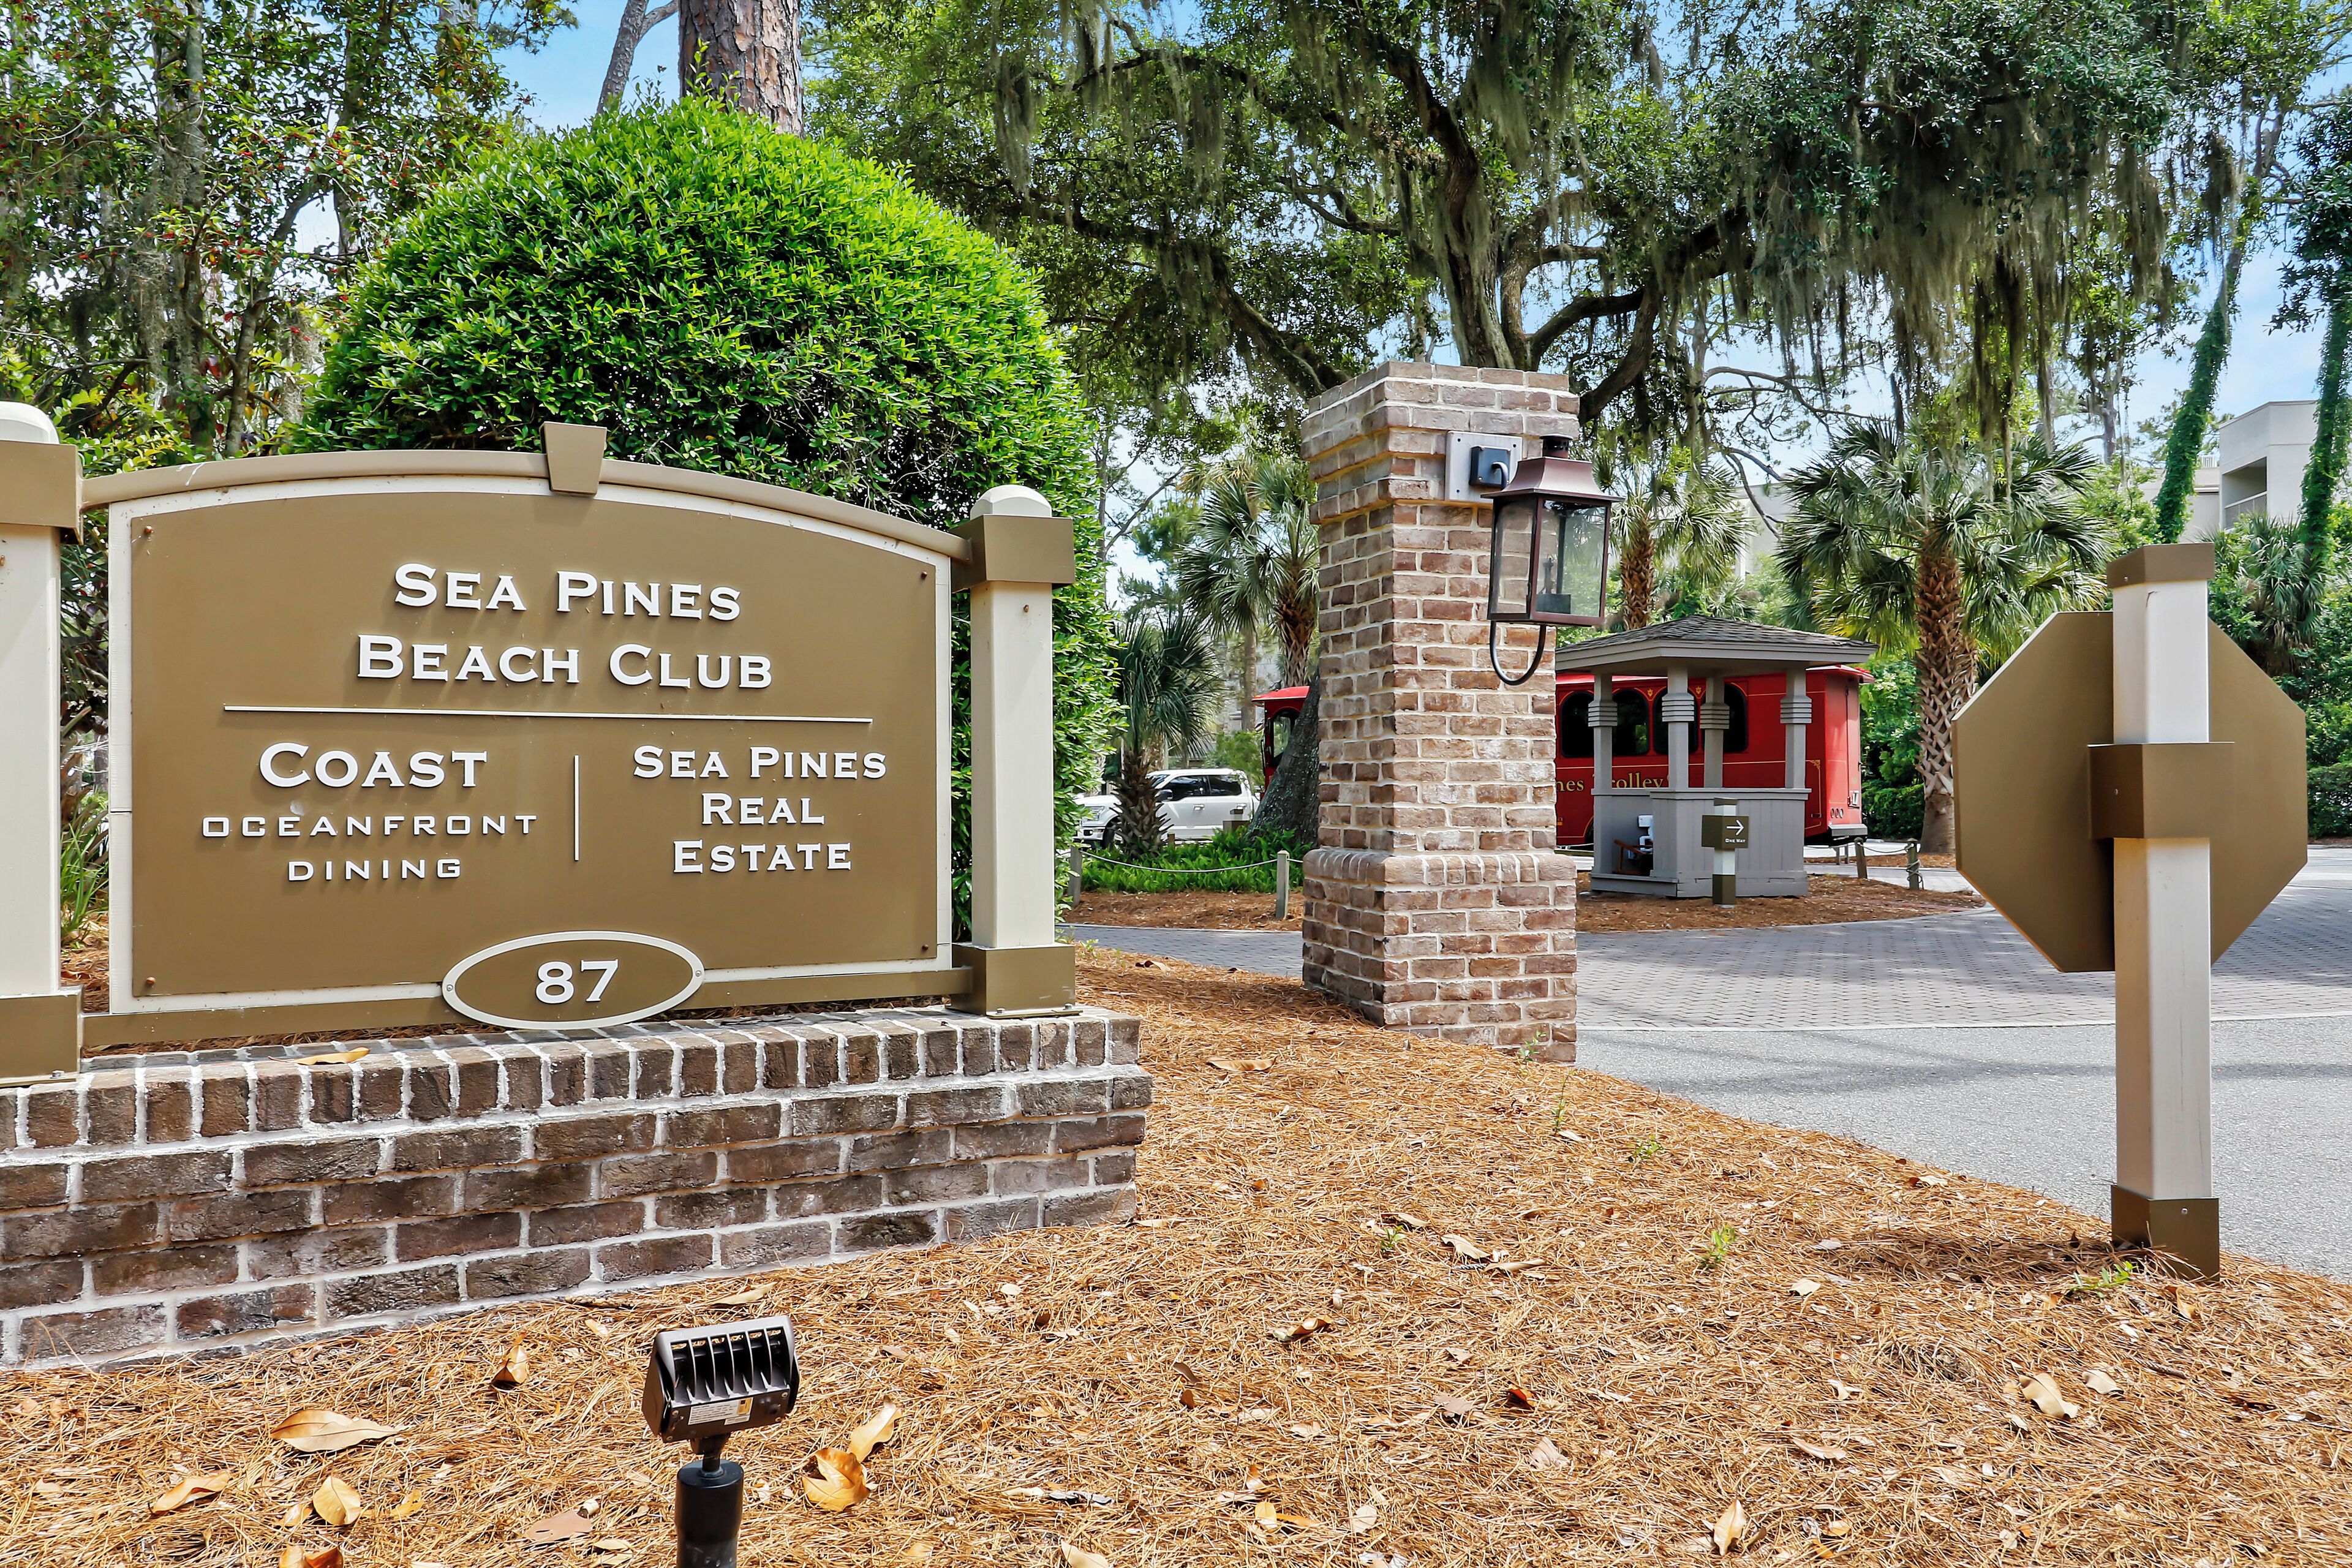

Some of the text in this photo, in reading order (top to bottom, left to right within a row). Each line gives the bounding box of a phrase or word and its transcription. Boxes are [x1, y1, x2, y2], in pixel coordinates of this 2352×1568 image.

[395, 563, 741, 620] SEA PINES
[356, 634, 773, 688] BEACH CLUB
[260, 742, 488, 788] COAST
[633, 745, 888, 780] SEA PINES
[1556, 780, 1584, 791] nes
[202, 815, 537, 837] OCEANFRONT
[702, 793, 825, 825] REAL
[288, 859, 461, 881] DINING
[673, 839, 852, 874] ESTATE
[536, 959, 620, 1004] 87
